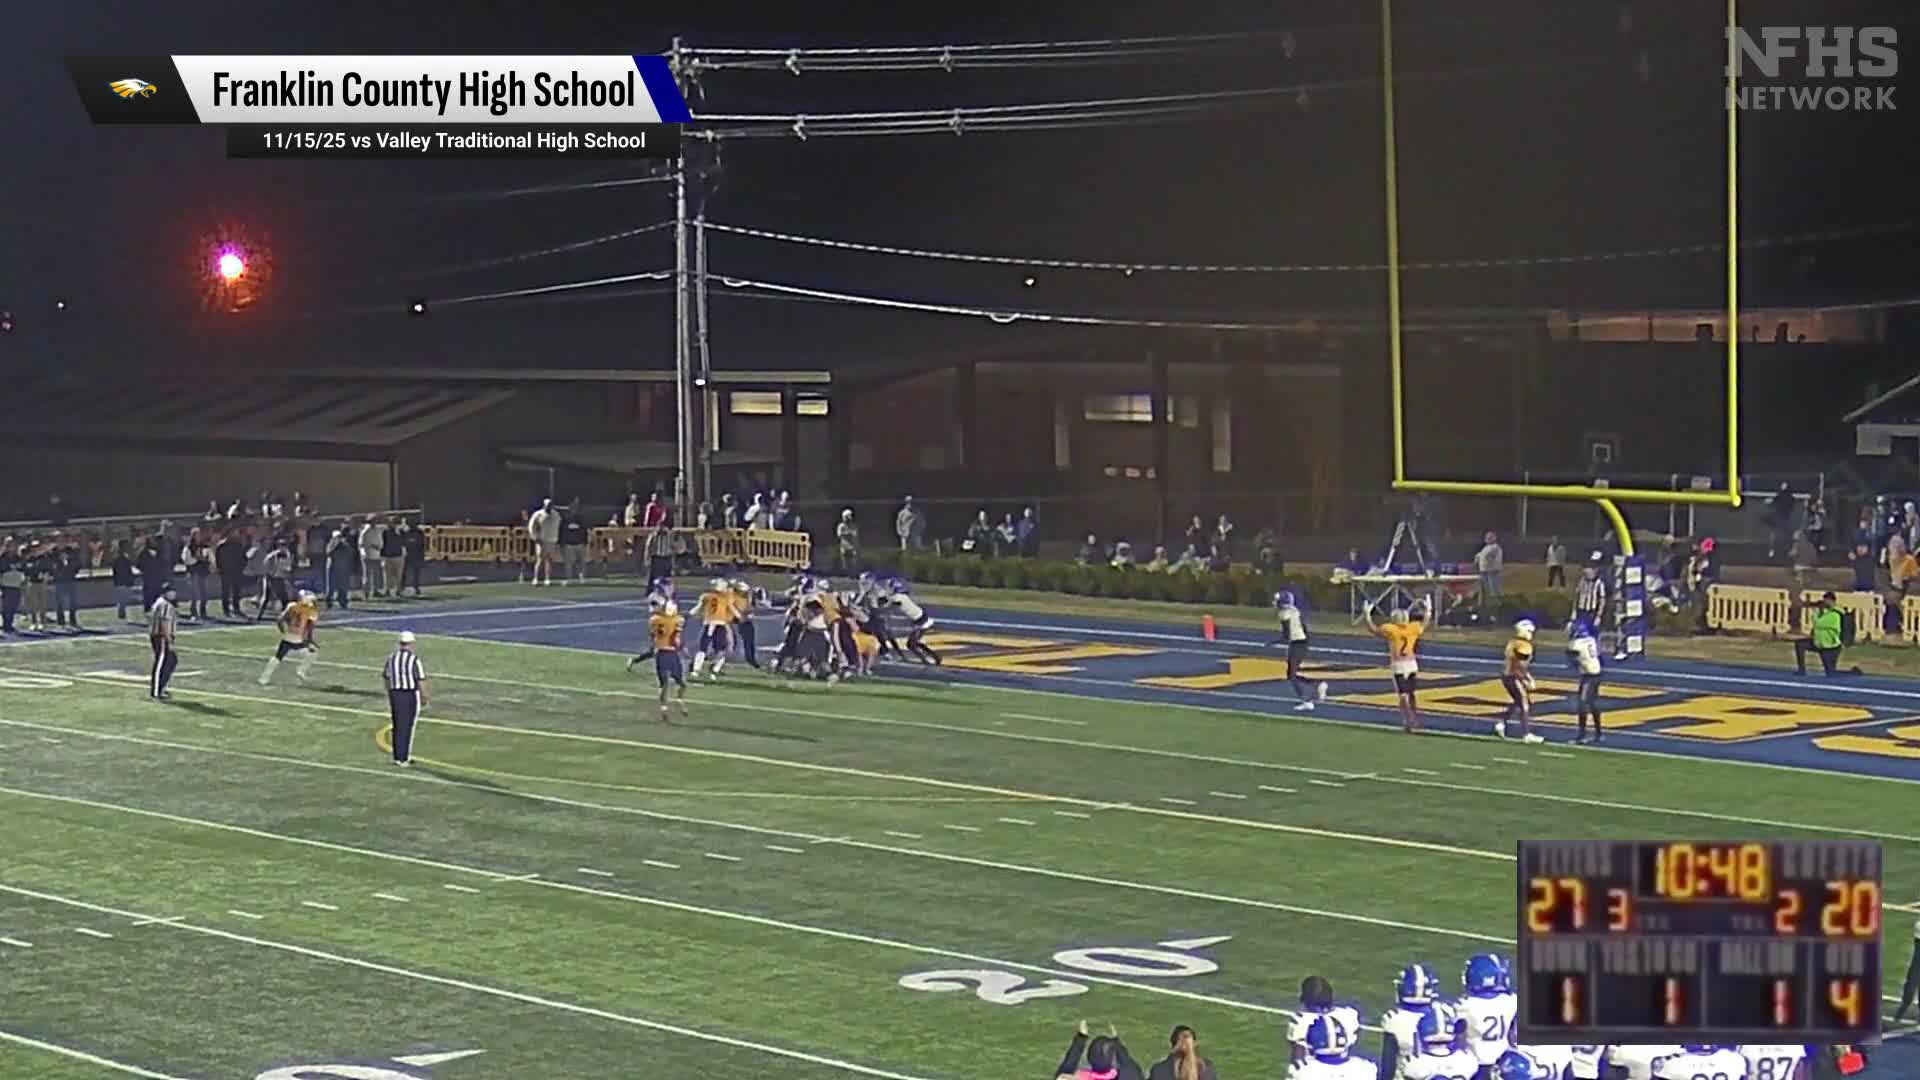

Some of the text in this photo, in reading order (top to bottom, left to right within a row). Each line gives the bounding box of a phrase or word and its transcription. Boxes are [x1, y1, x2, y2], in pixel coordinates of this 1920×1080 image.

[1399, 635, 1408, 656] 2
[1655, 843, 1768, 899] 10:48
[1527, 878, 1586, 932] 27
[1607, 889, 1629, 931] 3
[1775, 891, 1803, 933] 2
[1821, 881, 1879, 936] 20
[898, 946, 1219, 1006] 20
[1562, 976, 1575, 1024] 1
[1665, 978, 1680, 1024] 1
[1774, 980, 1787, 1024] 1
[1829, 980, 1859, 1024] 4
[1481, 1015, 1505, 1042] 21
[1757, 1056, 1793, 1080] 87
